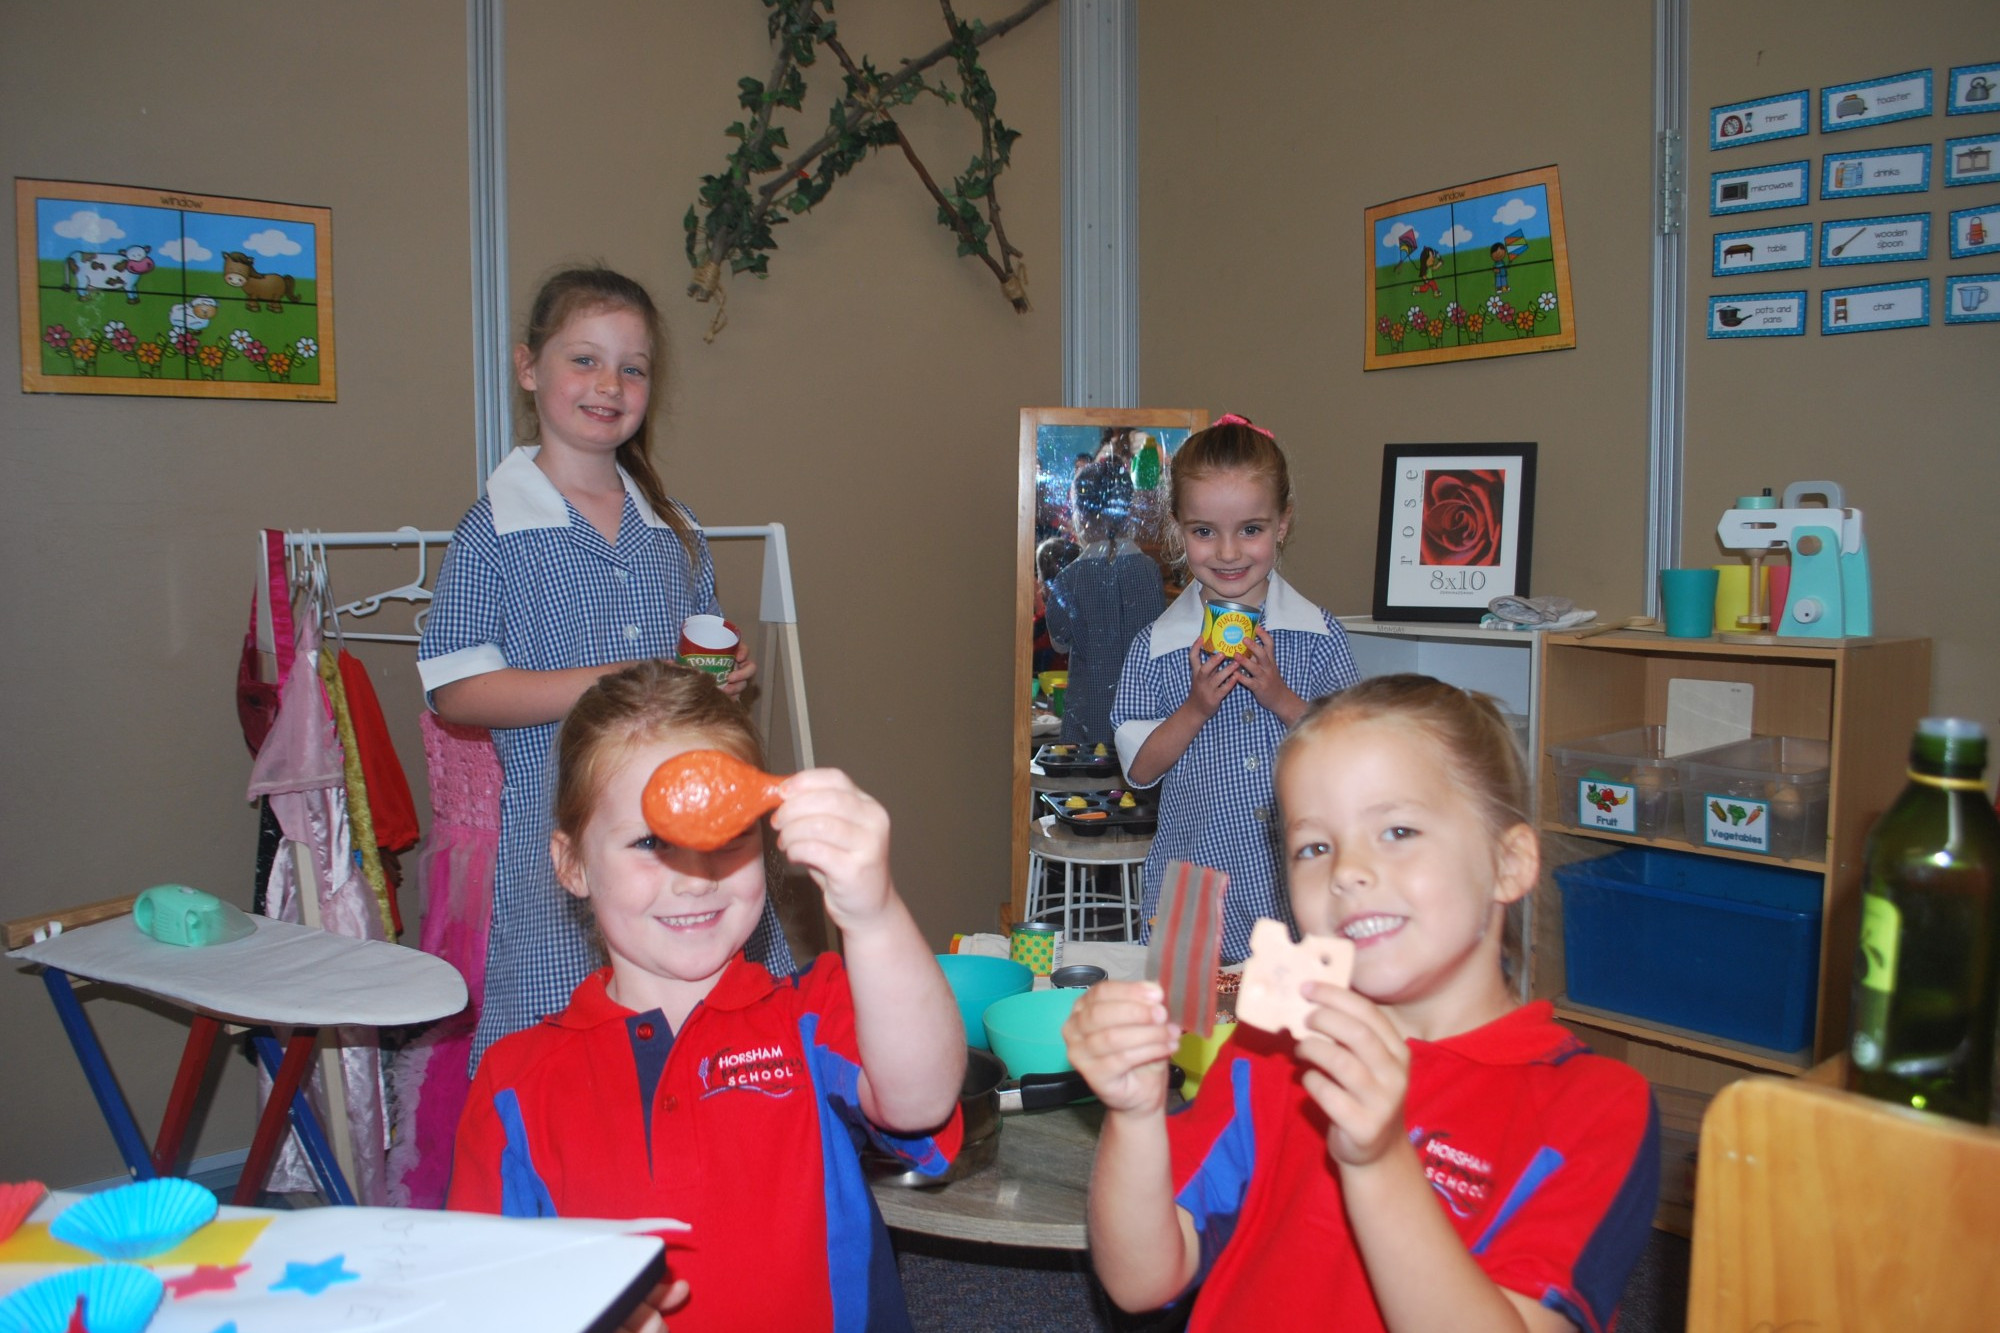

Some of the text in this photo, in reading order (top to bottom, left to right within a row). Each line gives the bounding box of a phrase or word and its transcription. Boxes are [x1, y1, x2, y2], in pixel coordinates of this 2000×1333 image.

[1877, 92, 1911, 105] toaster
[1765, 113, 1788, 123] timer
[1874, 167, 1900, 178] drinks
[1751, 181, 1793, 192] microwave
[160, 196, 203, 208] window
[1875, 228, 1908, 239] wooden
[1767, 243, 1787, 252] table
[1877, 239, 1904, 249] spoon
[1755, 304, 1792, 315] pots and
[1872, 301, 1896, 312] chair
[1762, 315, 1783, 325] pans
[1430, 570, 1486, 590] 8x10
[1596, 815, 1618, 827] Fruit
[1710, 828, 1763, 845] Vegetables
[718, 1044, 783, 1069] HORSHAM
[728, 1066, 794, 1087] SCHOOL
